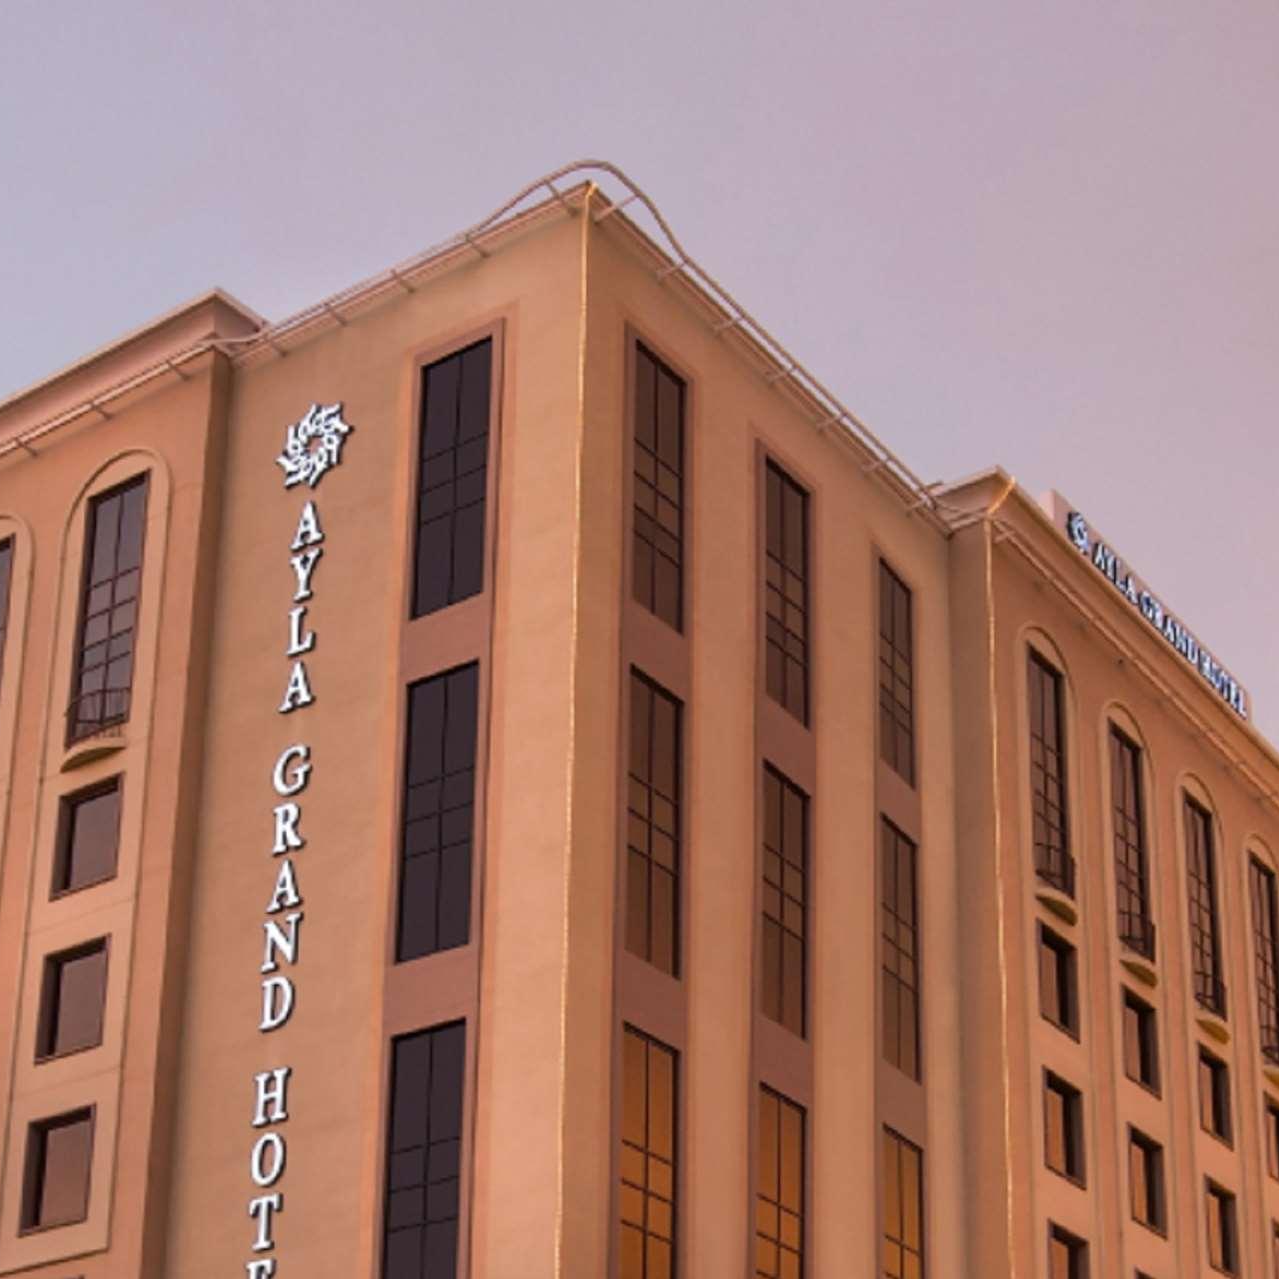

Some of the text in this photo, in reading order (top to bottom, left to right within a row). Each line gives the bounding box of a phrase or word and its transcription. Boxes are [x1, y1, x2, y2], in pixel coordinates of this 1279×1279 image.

[278, 500, 324, 715] AYLA
[1093, 542, 1139, 605] AYLA
[259, 744, 312, 1032] GRAND
